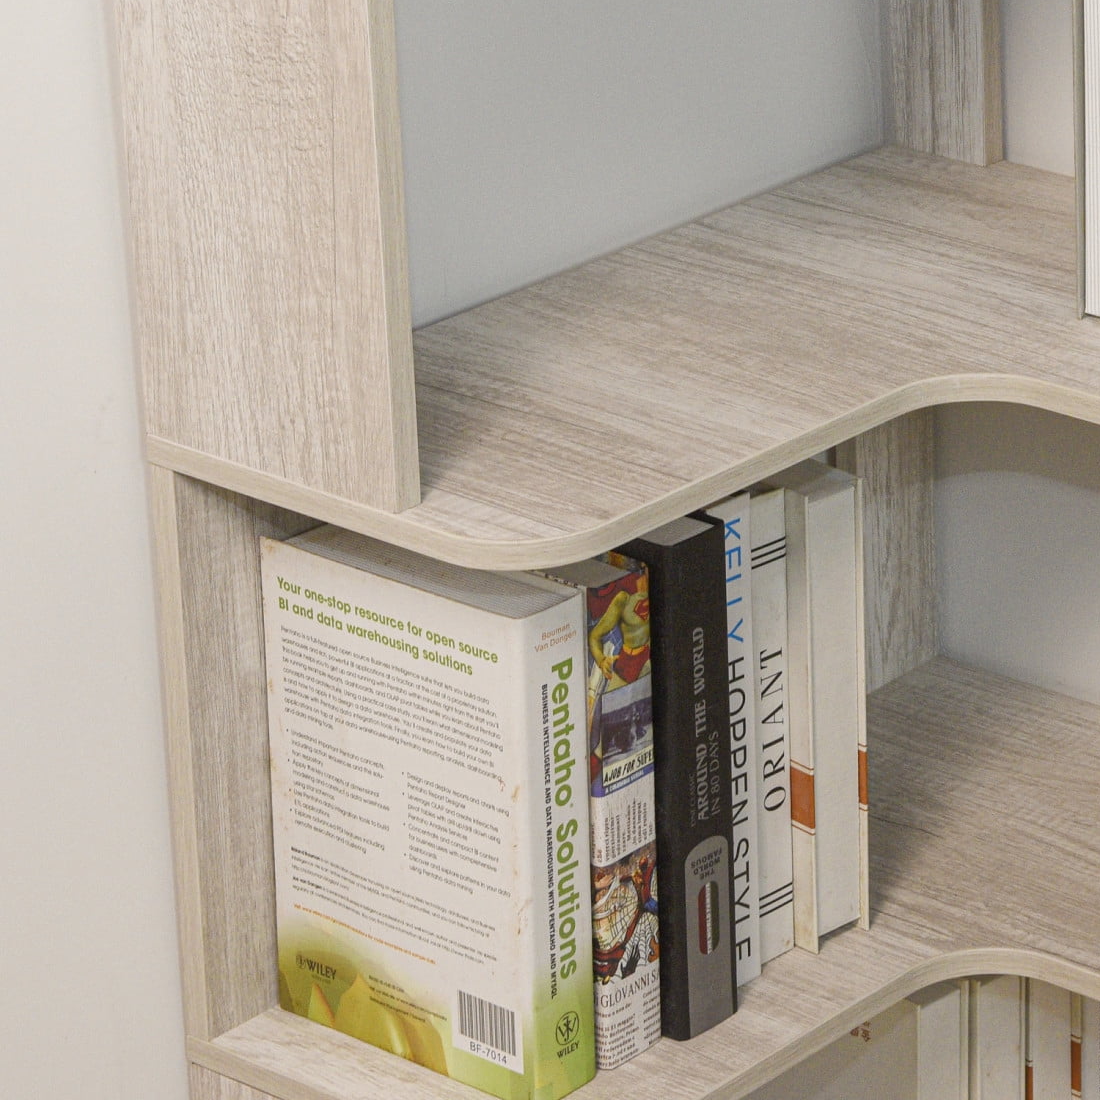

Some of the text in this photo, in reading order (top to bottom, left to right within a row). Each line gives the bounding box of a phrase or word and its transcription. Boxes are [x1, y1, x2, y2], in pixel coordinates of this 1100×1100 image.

[277, 576, 498, 663] Your one-stop resource for open source
[279, 597, 473, 676] BI and data warehousing solutions
[534, 629, 577, 653] Van Dongen
[541, 623, 570, 641] Bouman
[541, 684, 549, 724] BUSINESS
[693, 627, 709, 821] AROUND THE WORLD
[759, 647, 787, 812] ORIANT
[543, 726, 551, 785] INTELLIGENCE
[729, 656, 749, 827] HOPPEN
[709, 731, 721, 817] IN 80 DAYS
[545, 806, 553, 827] DATA
[551, 657, 580, 980] Pentaho Solutions
[546, 828, 554, 889] WAREHOUSING
[305, 956, 337, 981] WILEY
[468, 1040, 508, 1066] BF-7014
[557, 1040, 580, 1060] WILEY
